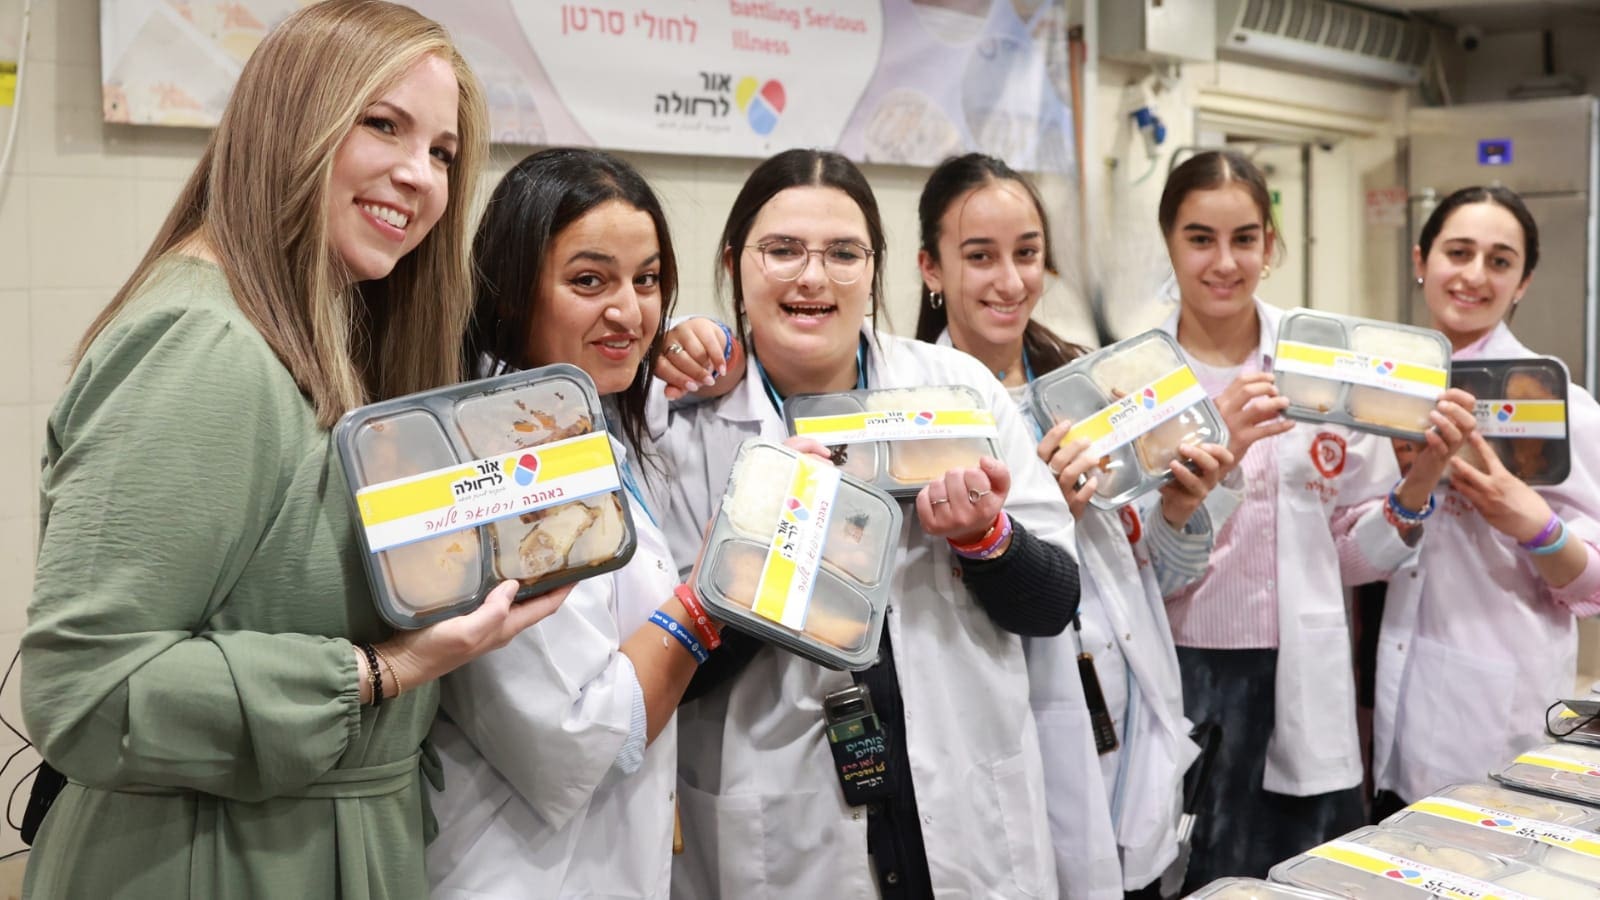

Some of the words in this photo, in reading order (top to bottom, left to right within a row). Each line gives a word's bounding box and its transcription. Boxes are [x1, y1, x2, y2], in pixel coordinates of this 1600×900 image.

[561, 4, 625, 36] סרטן
[633, 9, 698, 43] לחולי
[730, 0, 800, 30] battling
[804, 7, 867, 32] Serious
[732, 29, 789, 55] Illness
[699, 71, 731, 92] אור
[655, 90, 730, 116] לחולה
[454, 474, 503, 495] לחולה
[522, 487, 564, 506] באהבה
[424, 506, 458, 531] שלמה
[465, 500, 514, 521] ורפואה
